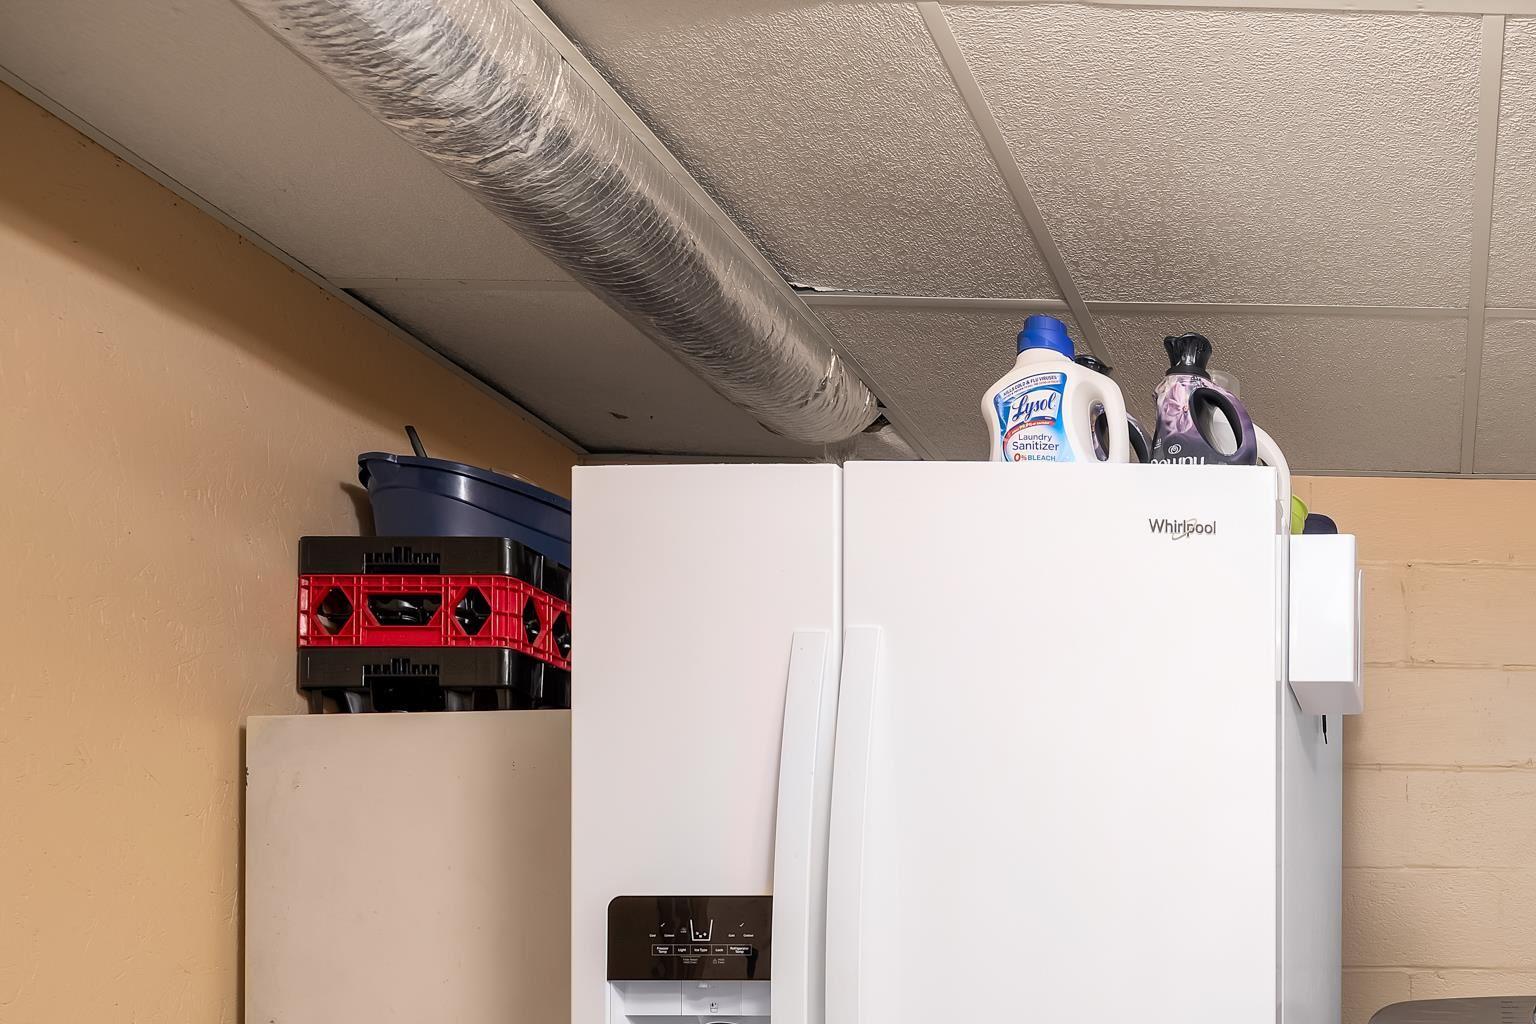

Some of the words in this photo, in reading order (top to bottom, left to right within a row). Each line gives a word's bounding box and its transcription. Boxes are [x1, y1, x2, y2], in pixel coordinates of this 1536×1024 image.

[1012, 392, 1057, 422] Lysol
[1018, 433, 1053, 442] Laundry
[1012, 441, 1060, 451] Sanitizer
[1014, 453, 1027, 462] 0%
[1148, 518, 1216, 538] Whirlpool
